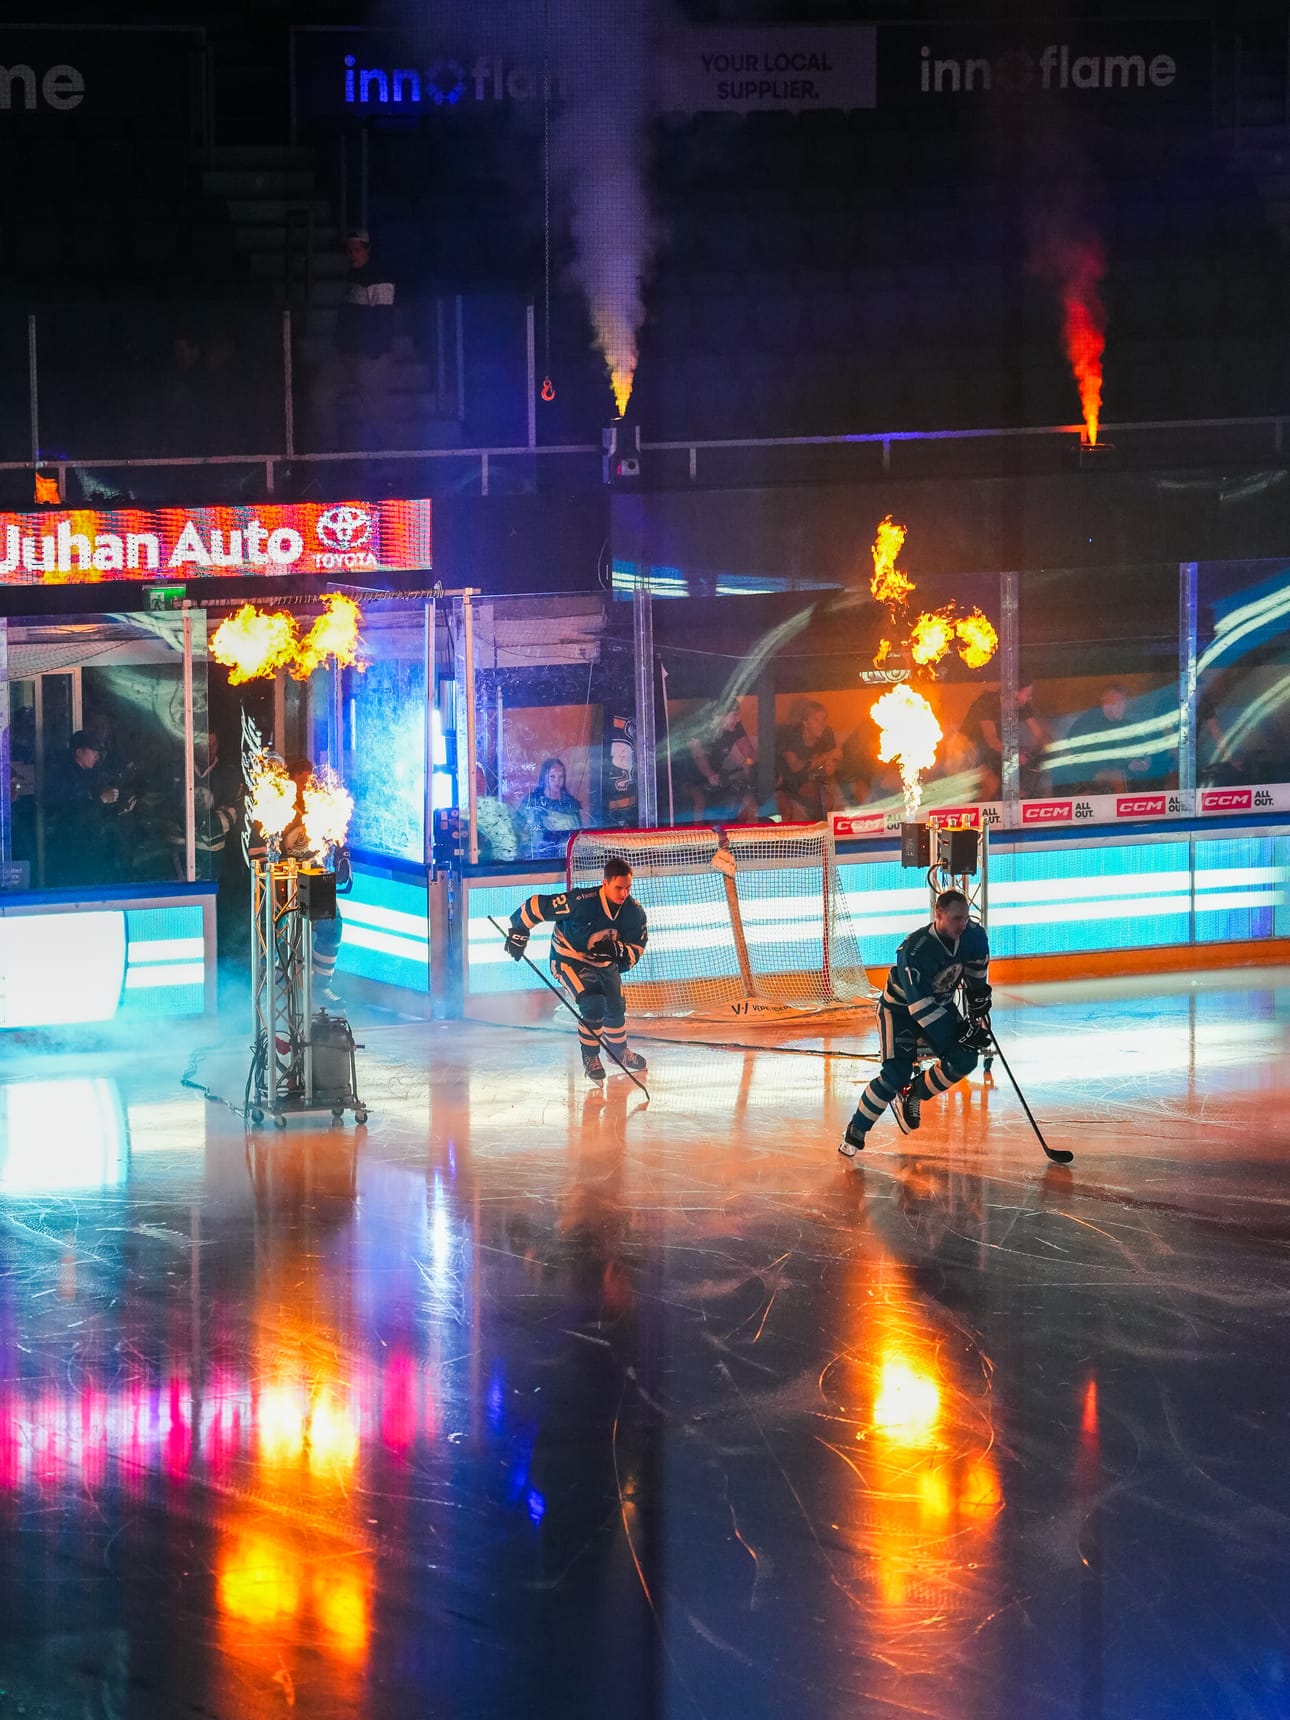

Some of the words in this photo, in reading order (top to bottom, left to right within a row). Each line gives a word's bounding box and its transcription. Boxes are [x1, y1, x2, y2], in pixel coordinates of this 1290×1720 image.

[702, 54, 758, 72] YOUR
[764, 53, 832, 72] LOCAL
[718, 81, 820, 99] SUPPLIER.
[0, 520, 159, 573] Juhan
[167, 520, 303, 567] Auto
[313, 553, 378, 569] TOYOTA
[1255, 790, 1271, 799] ALL
[1168, 796, 1180, 804] AL
[1204, 795, 1249, 807] CCM
[1254, 798, 1274, 807] OUT.
[1075, 802, 1091, 811] ALL
[1119, 801, 1164, 812] CCM
[1168, 804, 1181, 813] OU
[982, 808, 998, 816] ALL
[1025, 807, 1071, 819] CCM
[1074, 810, 1095, 819] OUT.
[886, 822, 902, 831] OU
[551, 894, 571, 915] 27
